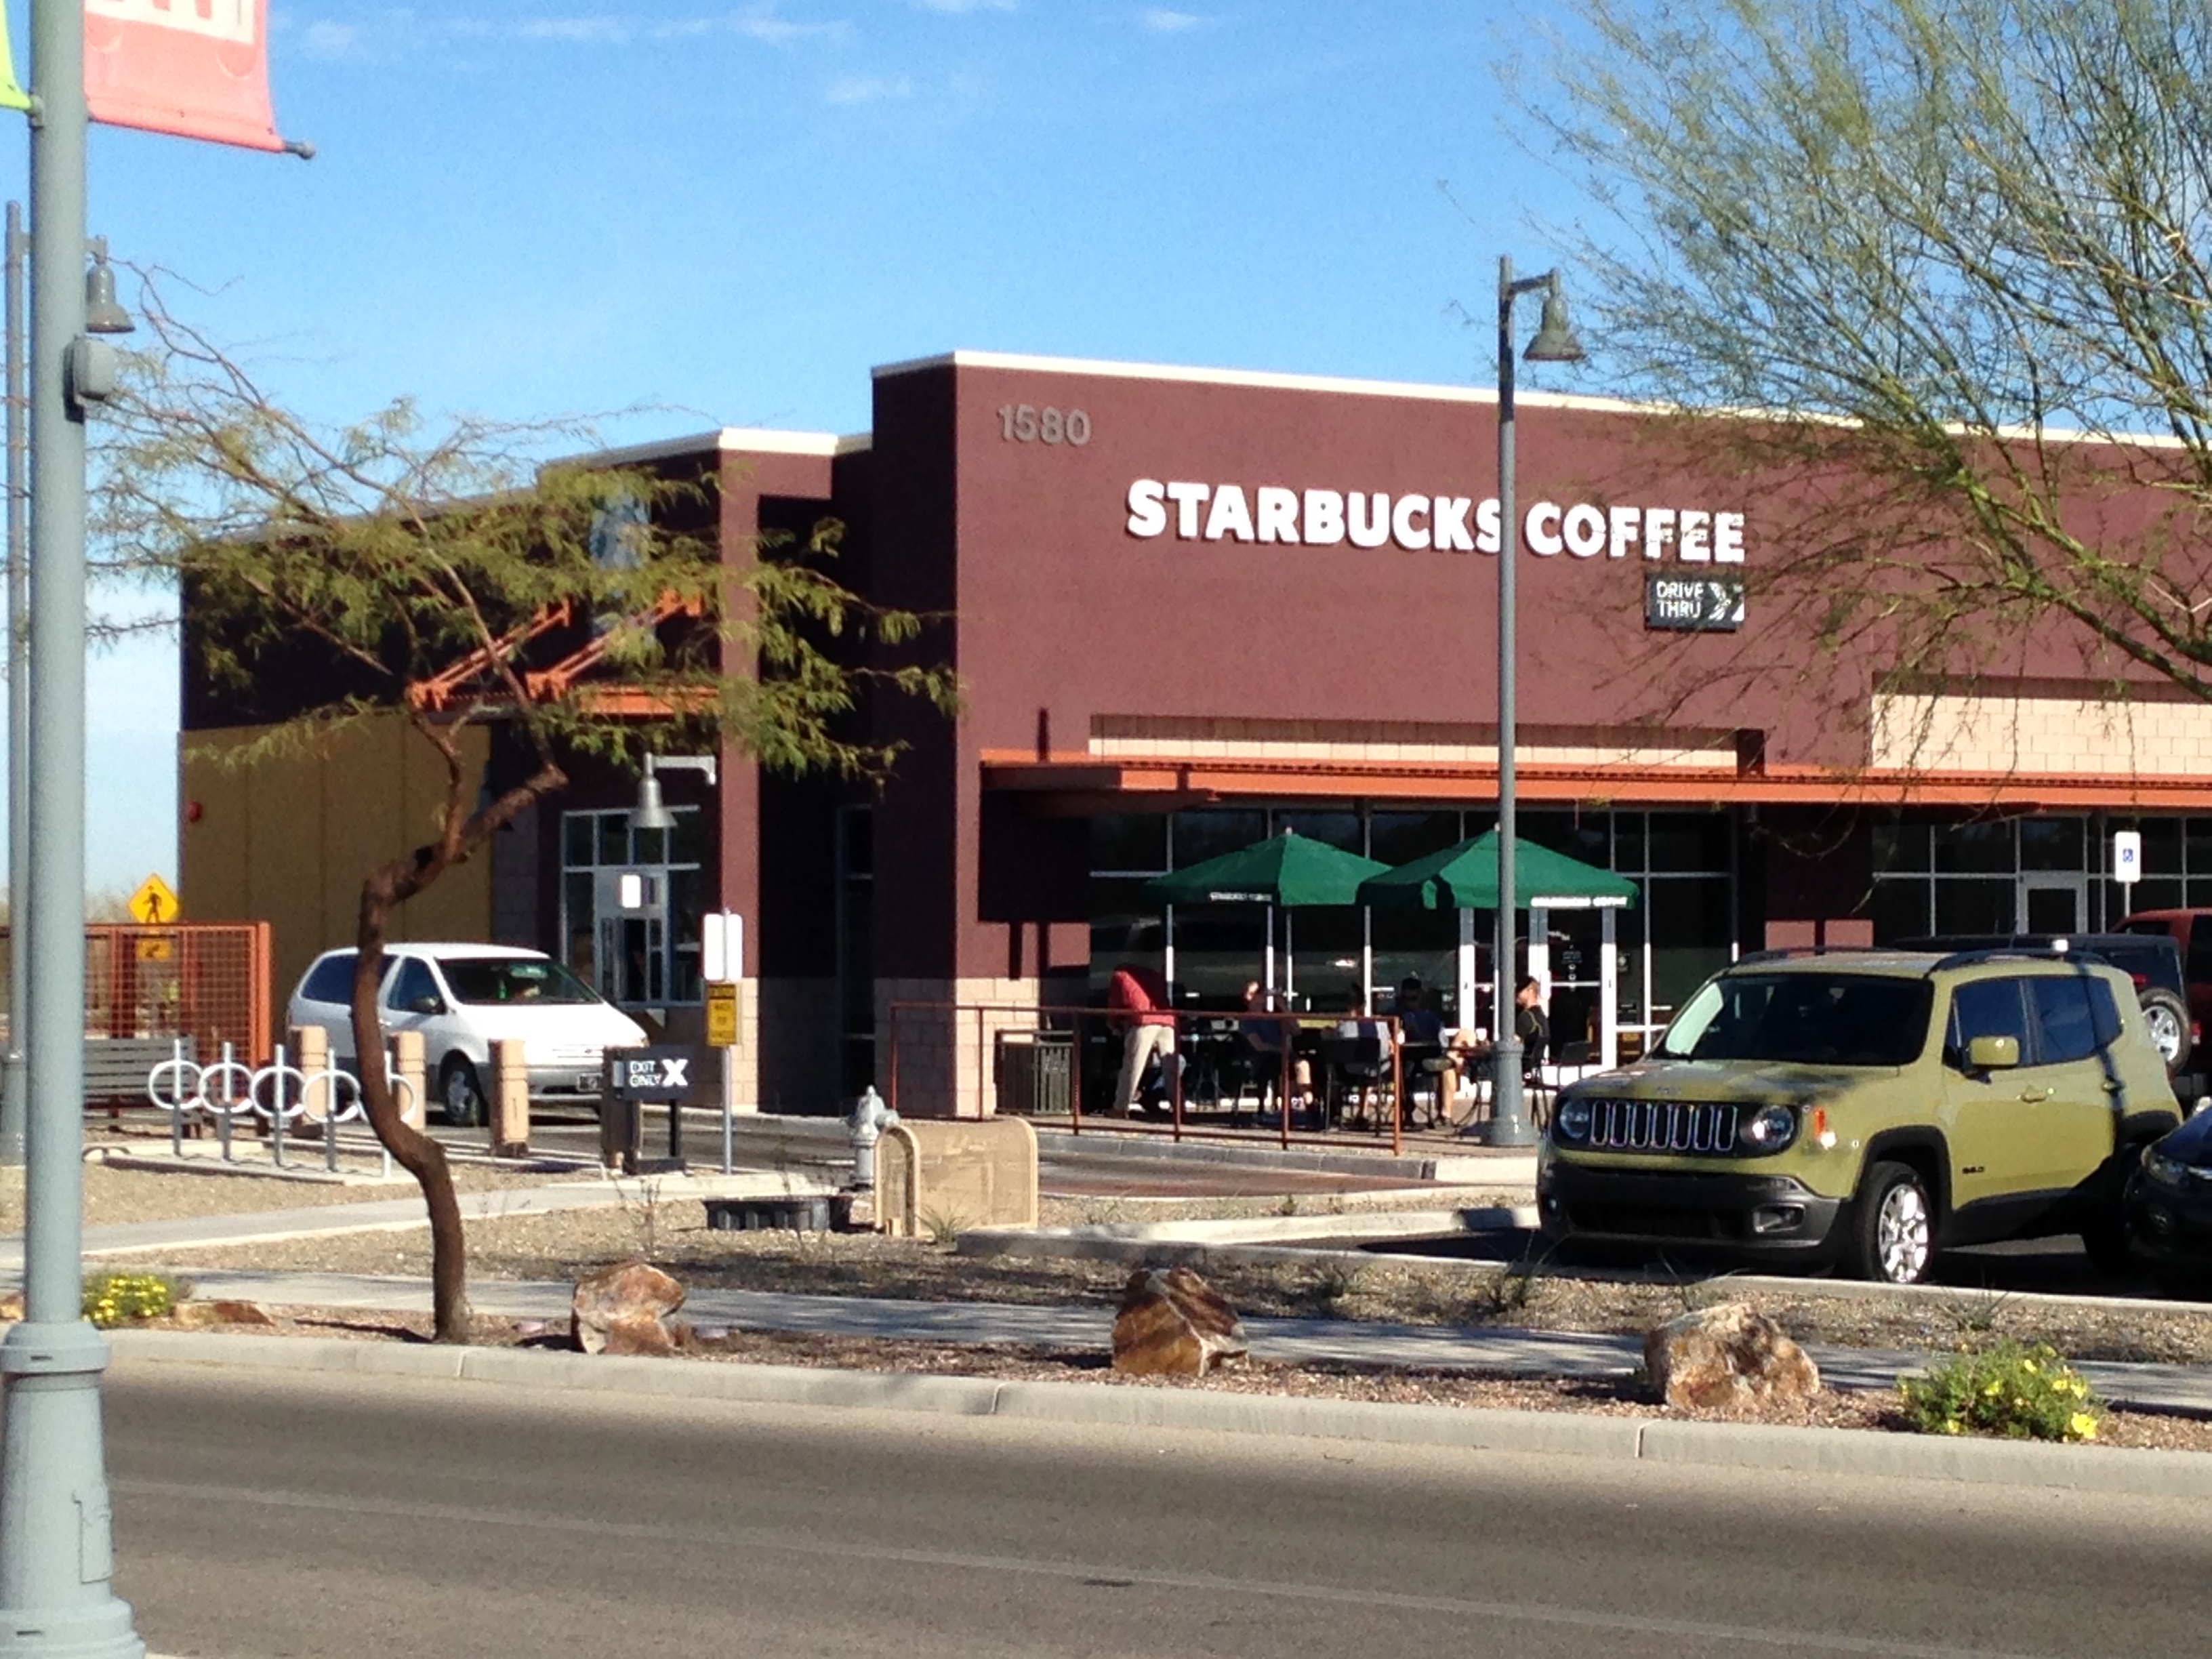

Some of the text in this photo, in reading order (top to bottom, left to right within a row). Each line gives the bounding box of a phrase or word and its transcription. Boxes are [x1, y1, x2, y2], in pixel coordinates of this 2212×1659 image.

[998, 404, 1091, 447] 1580
[1126, 478, 1745, 562] STARBUCKS COFFEE
[1656, 581, 1704, 598] DRIVE
[1657, 599, 1702, 618] THRU
